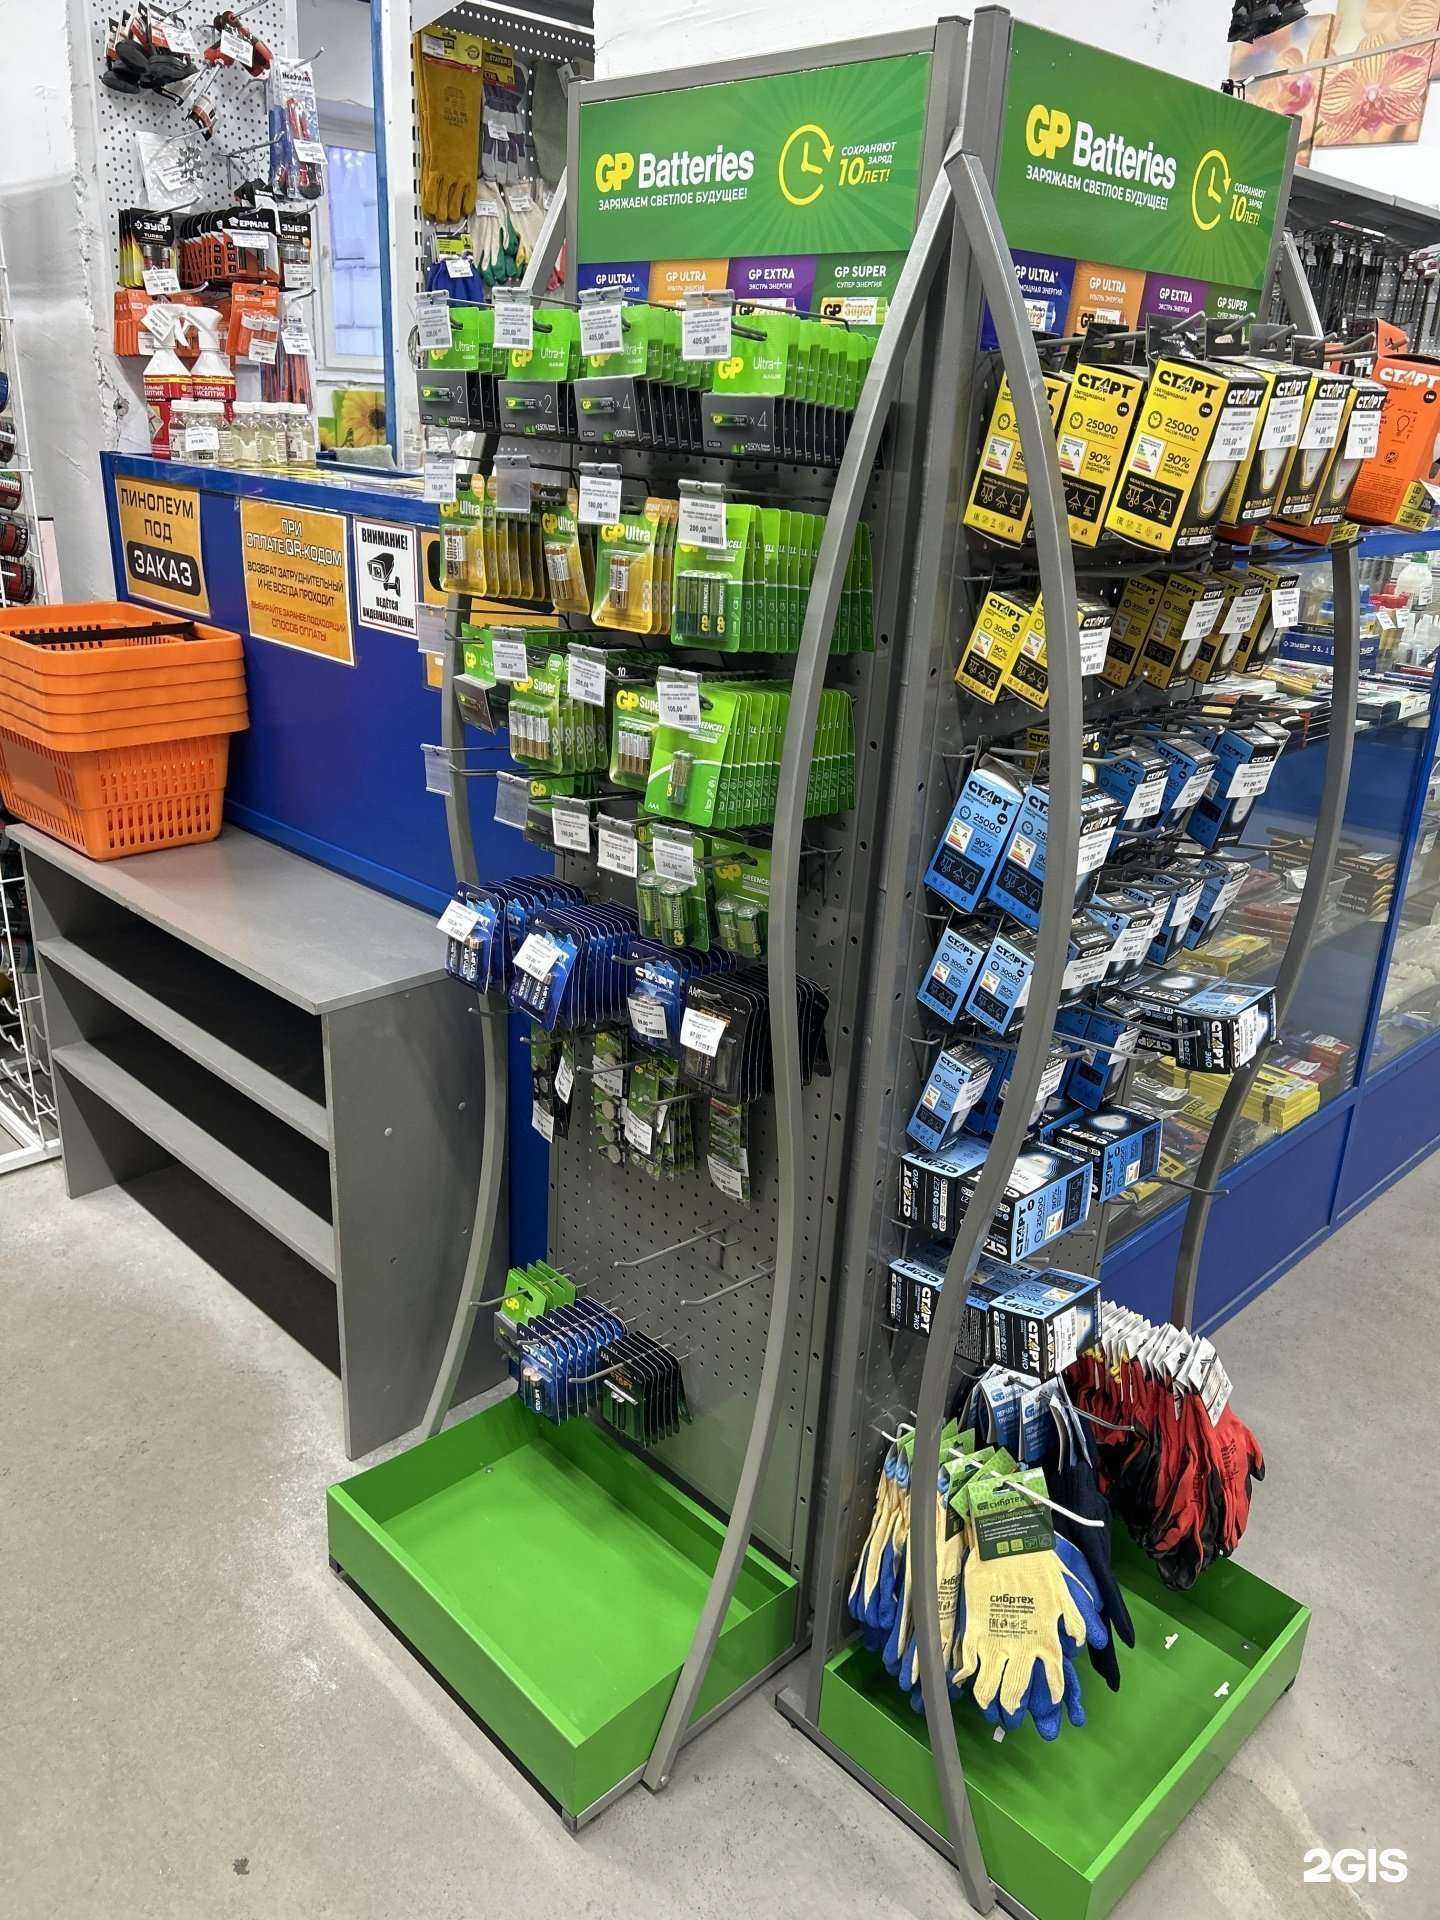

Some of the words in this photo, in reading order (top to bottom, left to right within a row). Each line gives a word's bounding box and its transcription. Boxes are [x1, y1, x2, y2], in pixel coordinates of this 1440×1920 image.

[841, 141, 896, 156] СОХРАНЯЮТ
[1026, 104, 1071, 159] GP
[1073, 121, 1177, 190] Batteries
[868, 154, 892, 165] ЗАРЯД
[595, 153, 634, 193] GP
[638, 145, 755, 188] Batteries
[838, 157, 865, 187] 10
[861, 169, 890, 184] ЛЕТ!
[1026, 165, 1081, 191] ЗАРЯЖАЕМ
[1083, 177, 1124, 201] СВЕТЛОЕ
[1126, 188, 1169, 211] БУДУЩЕЕ!
[1234, 182, 1268, 199] СОХРАНЯЮТ
[598, 191, 648, 211] ЗАРЯЖАЕМ
[650, 190, 693, 208] СВЕТЛОЕ
[696, 187, 748, 204] БУДУЩЕЕ!
[1229, 194, 1247, 223] 10
[1244, 211, 1260, 225] ЛЕТ!
[144, 223, 171, 233] ЗУБР
[239, 219, 270, 230] ЕРМАК
[281, 223, 308, 233] ЗУБР
[596, 274, 606, 285] GP
[665, 271, 679, 283] GP
[680, 270, 707, 282] ULTRA
[748, 268, 763, 281] GP
[764, 267, 794, 280] EXTRA
[834, 266, 851, 279] GP
[852, 265, 886, 278] SUPER
[1089, 276, 1102, 289] GP
[1103, 279, 1127, 293] ULTRA
[1159, 287, 1171, 301] GP
[1172, 289, 1193, 304] EXTRA
[1217, 296, 1227, 308] GP
[1228, 298, 1248, 312] SUPER
[823, 303, 842, 317] GP
[511, 350, 533, 367] GP
[541, 347, 563, 360] Ultra+
[717, 356, 744, 380] GP
[753, 357, 782, 371] Ultra+
[1077, 373, 1136, 399] СТАРТ
[1158, 370, 1220, 399] СТАРТ
[1379, 367, 1440, 389] СТАРТ
[1227, 388, 1263, 404] СТАРТ
[1276, 380, 1307, 397] СТАРТ
[1319, 383, 1349, 398] СТАРТ
[544, 394, 552, 414] 2
[623, 393, 631, 409] 4
[1356, 394, 1387, 409] СТАРТ
[757, 411, 768, 433] 4
[1086, 417, 1118, 435] 25000
[1165, 417, 1200, 437] 25000
[1088, 450, 1111, 466] 90%
[1166, 452, 1191, 469] 90%
[121, 487, 194, 520] ЛИНОЛЕУМ
[440, 502, 459, 516] GP
[460, 500, 481, 515] Ultra
[144, 519, 173, 544] ПОД
[281, 517, 303, 537] ПРИ
[542, 513, 558, 534] GP
[558, 515, 575, 531] Ultra
[601, 522, 625, 542] GP
[625, 523, 650, 543] Ultra
[246, 532, 286, 556] ОПЛАТЕ
[362, 527, 409, 551] ВНИМАНИЕ!
[134, 550, 192, 588] ЗАКАЗ
[247, 560, 278, 579] ВОЗВРАТ
[264, 583, 273, 592] НЕ
[273, 584, 298, 600] ВСЕГДА
[299, 589, 336, 606] ПРОХОДИТ
[1130, 579, 1158, 595] СТАРТ
[1170, 581, 1199, 597] СТАРТ
[1203, 590, 1223, 599] СТАРТ
[989, 598, 1024, 622] СТАРТ
[271, 619, 299, 636] СПОСОБ
[300, 625, 327, 642] ОПЛАТЫ
[701, 615, 710, 632] GP
[1084, 616, 1110, 627] СТАРТ
[993, 623, 1016, 640] 30000
[465, 651, 477, 668] GP
[994, 644, 1008, 657] 90%
[534, 679, 556, 693] Super
[616, 690, 639, 710] GP
[1158, 747, 1194, 771] СТАРТ
[1252, 755, 1274, 763] СТАРТ
[1146, 769, 1167, 781] СТАРТ
[531, 781, 547, 796] GP
[968, 780, 1014, 812] СТАРТ
[973, 812, 1002, 834] 25000
[1082, 815, 1116, 834] СТАРТ
[975, 837, 992, 853] 90%
[715, 858, 741, 881] GP
[673, 930, 684, 945] GP
[948, 935, 976, 957] СТАРТ
[996, 944, 1028, 968] СТАРТ
[1082, 944, 1110, 958] СТАРТ
[1000, 985, 1013, 996] 90%
[1211, 1020, 1225, 1069] СТАРТ
[940, 1056, 968, 1077] СТАРТ
[903, 1164, 914, 1217] СТАРТ
[1016, 1206, 1027, 1258] СТАРТ
[921, 1286, 932, 1334] СТАРТ
[999, 1299, 1044, 1316] СТАРТ
[1028, 1320, 1040, 1374] СТАРТ
[990, 1593, 1034, 1604] сибртех
